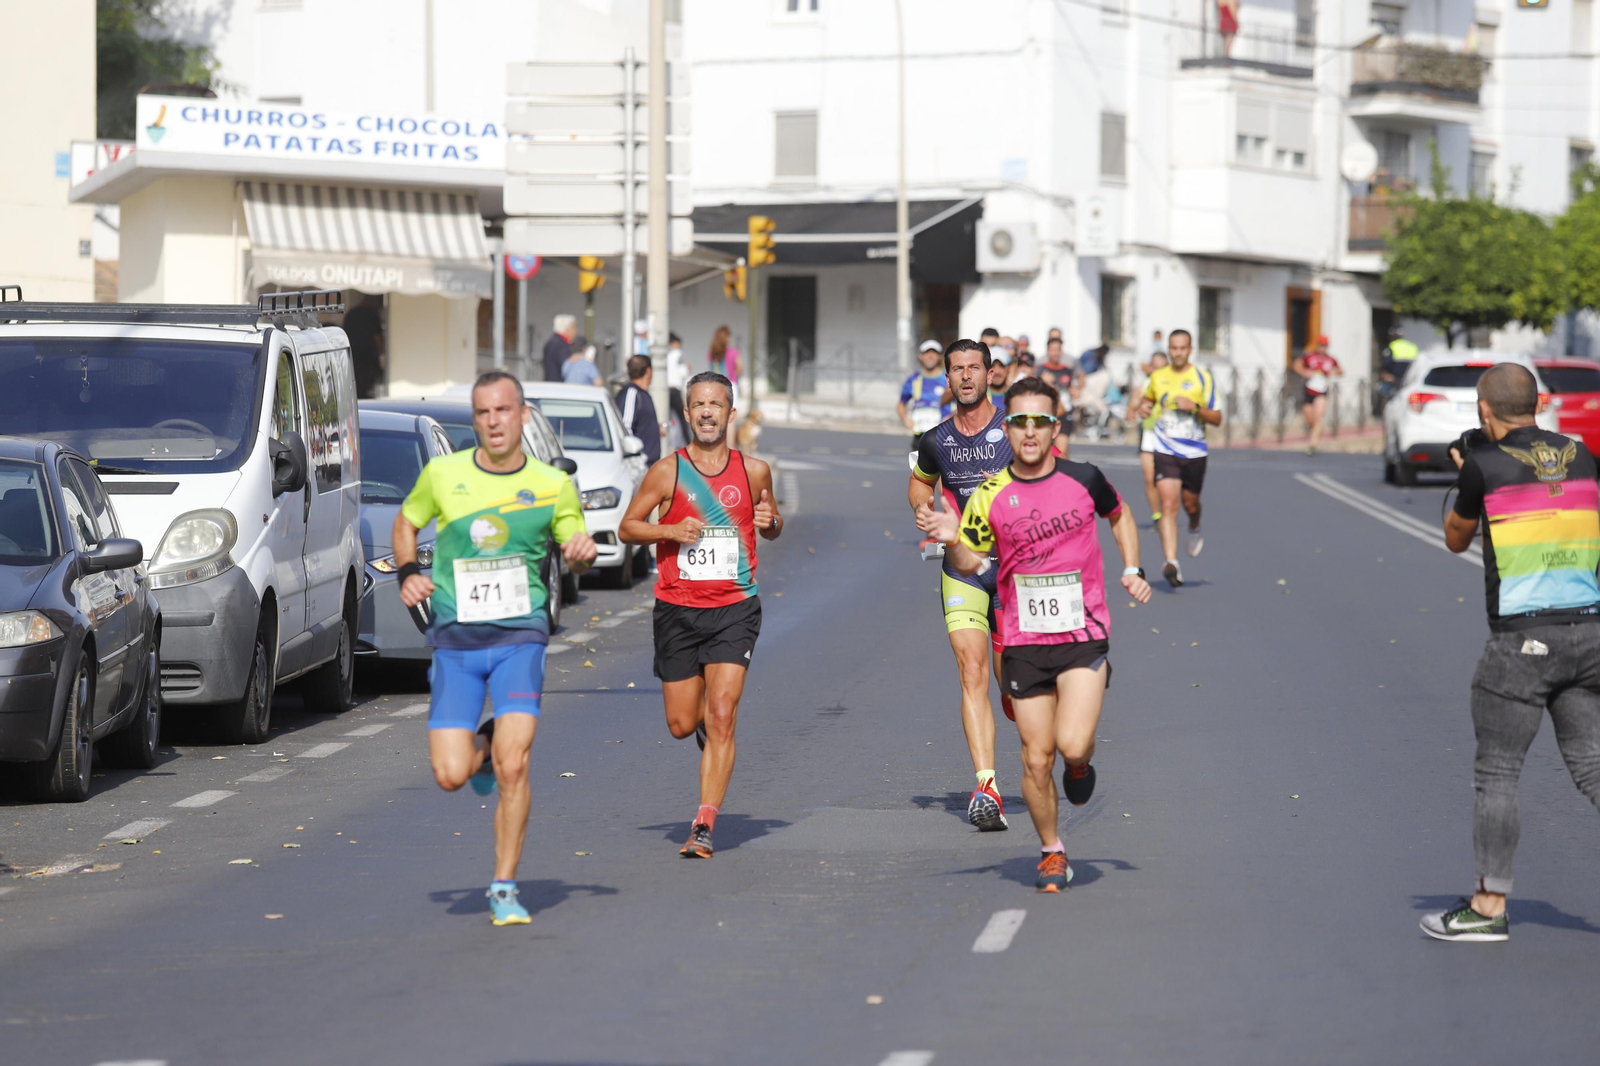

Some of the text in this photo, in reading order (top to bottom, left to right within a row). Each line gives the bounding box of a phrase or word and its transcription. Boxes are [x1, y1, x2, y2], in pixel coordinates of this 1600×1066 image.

[182, 106, 327, 130] CHURROS
[357, 115, 508, 139] CHOCOLA
[223, 132, 480, 162] PATATAS FRITAS
[321, 263, 404, 289] ONUTAPI
[950, 443, 996, 463] NARANJO
[714, 529, 734, 537] HUELVA
[1024, 508, 1084, 545] TIGRES
[687, 548, 715, 566] 631
[1053, 574, 1077, 586] HUELVA
[470, 583, 502, 604] 471
[1028, 598, 1060, 617] 618
